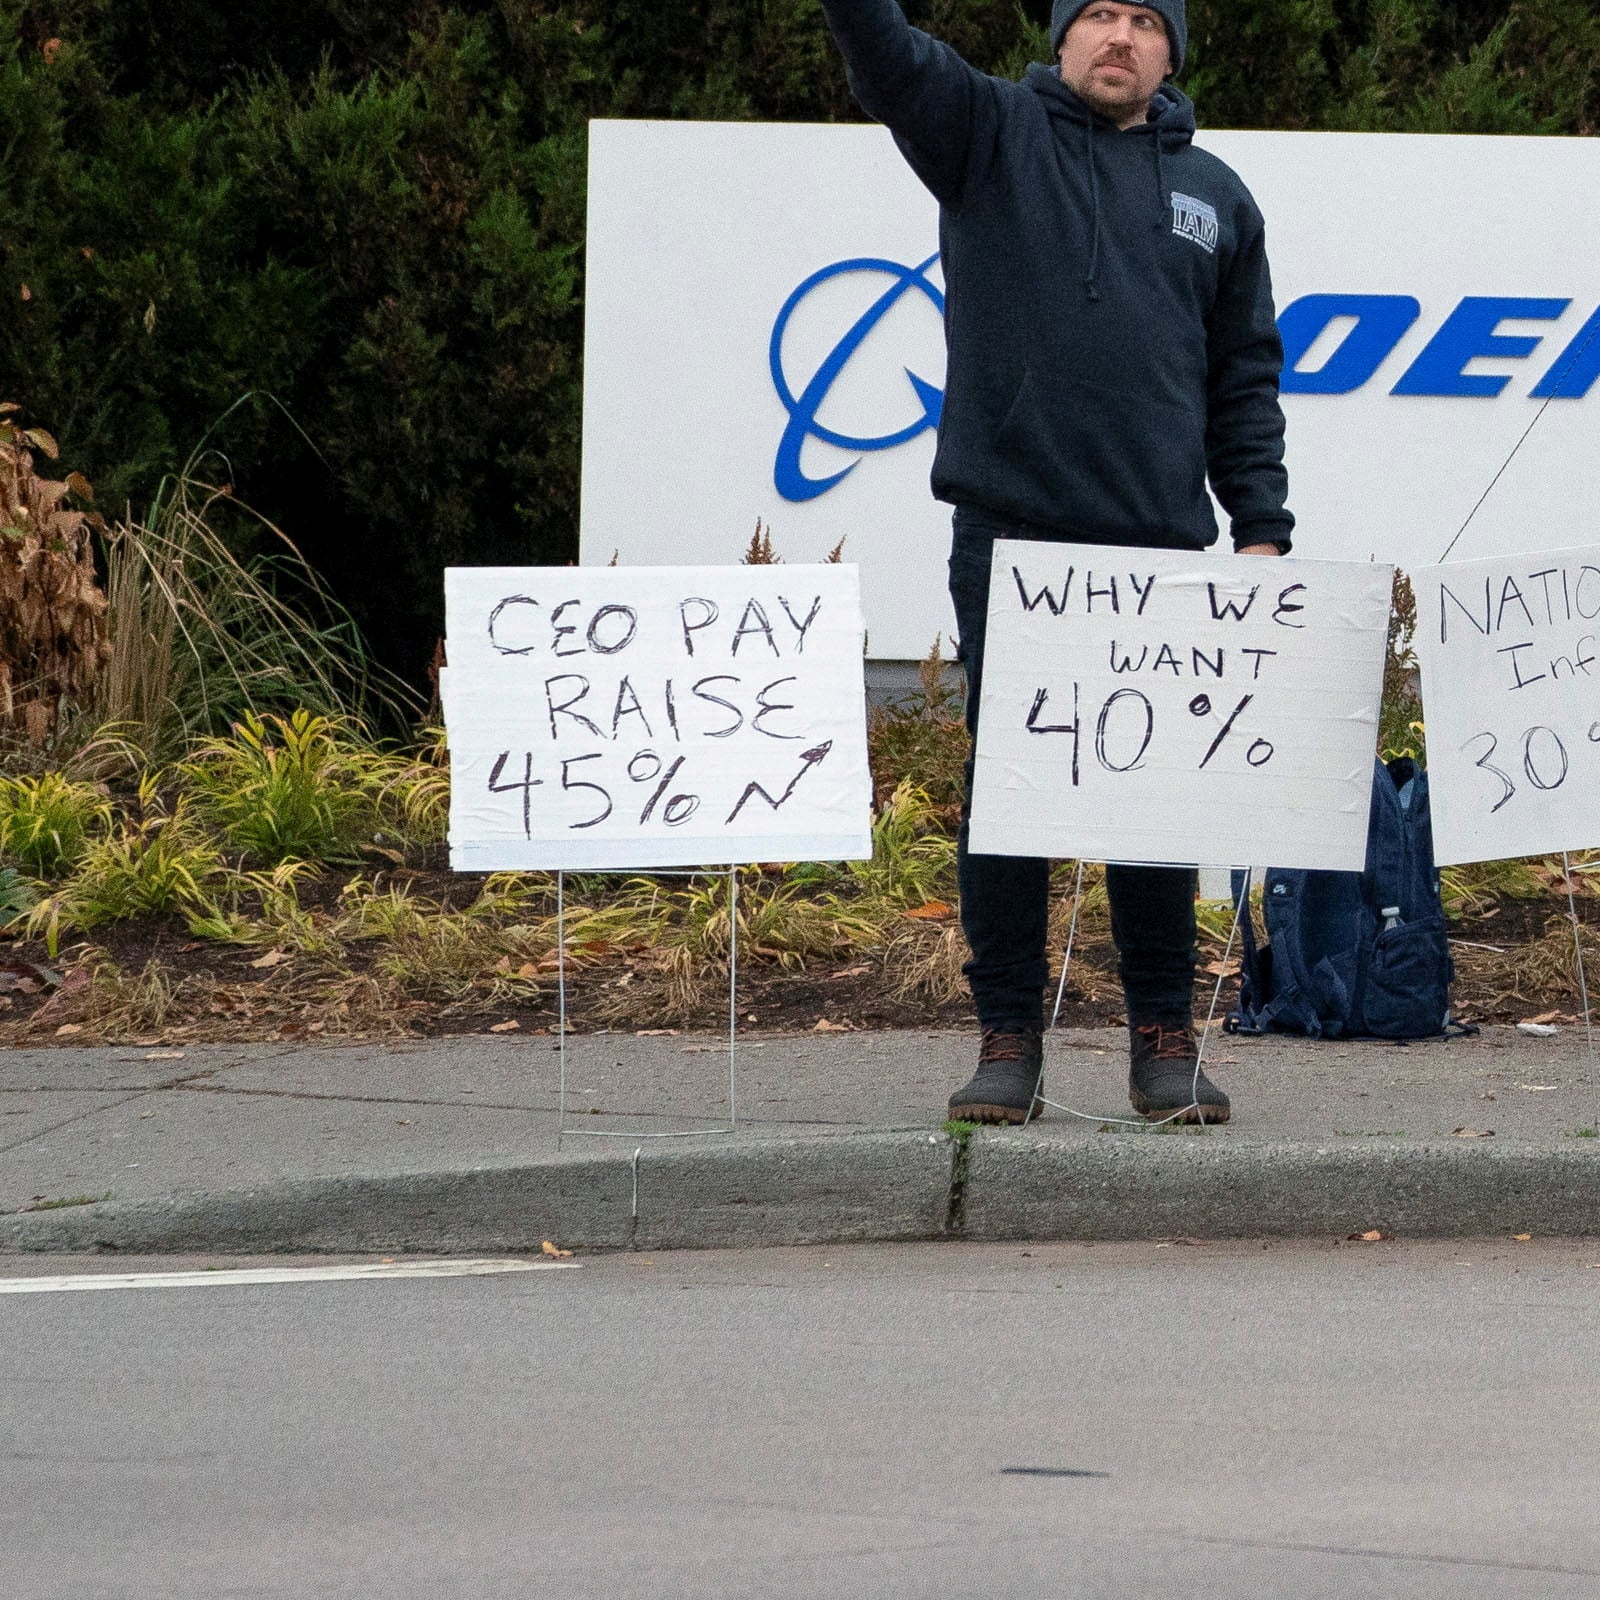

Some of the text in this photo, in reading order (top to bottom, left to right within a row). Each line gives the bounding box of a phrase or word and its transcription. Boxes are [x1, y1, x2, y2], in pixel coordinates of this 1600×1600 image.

[1173, 208, 1219, 248] IAM
[488, 594, 821, 657] CEO PAY
[1012, 565, 1308, 628] WHY WE
[1110, 640, 1278, 679] WANT
[545, 674, 806, 742] RAISE
[488, 749, 701, 841] 45%
